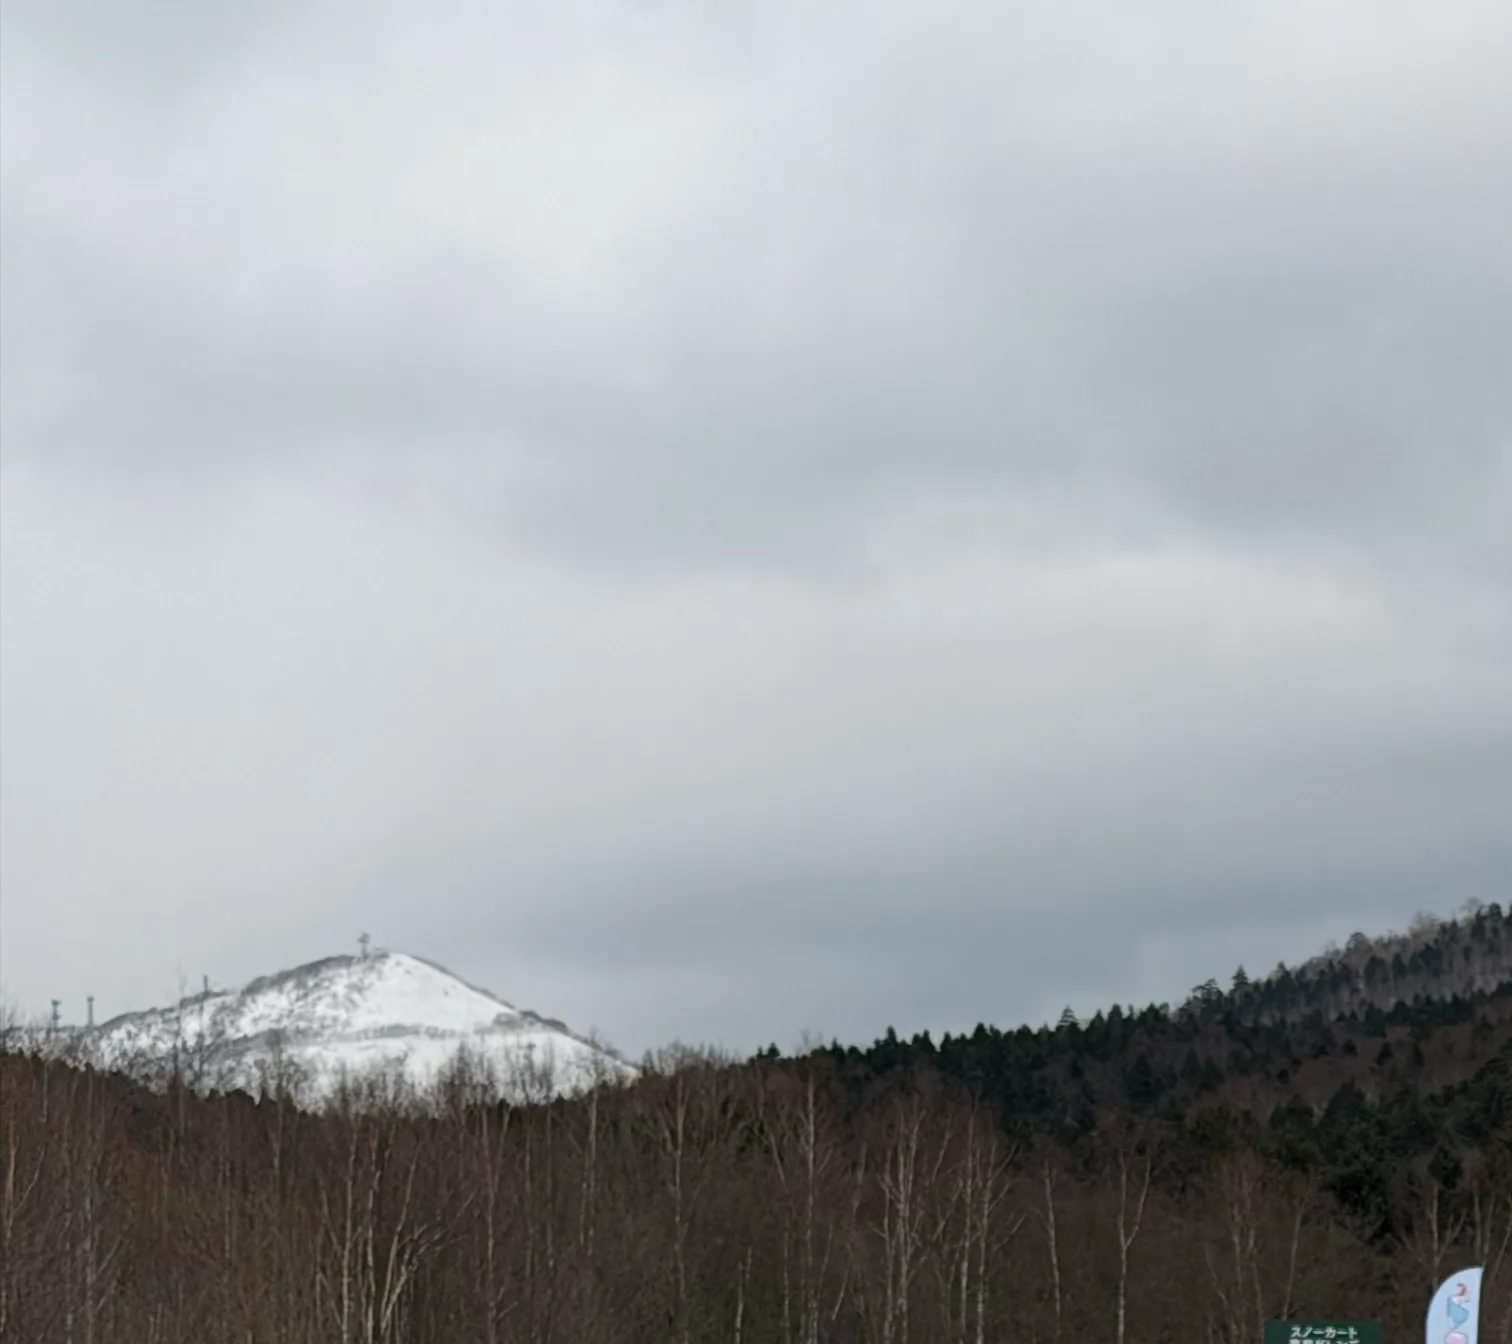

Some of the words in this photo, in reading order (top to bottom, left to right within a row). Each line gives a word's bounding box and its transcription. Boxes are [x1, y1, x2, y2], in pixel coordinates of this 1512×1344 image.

[1291, 1325, 1358, 1339] スノーカート
